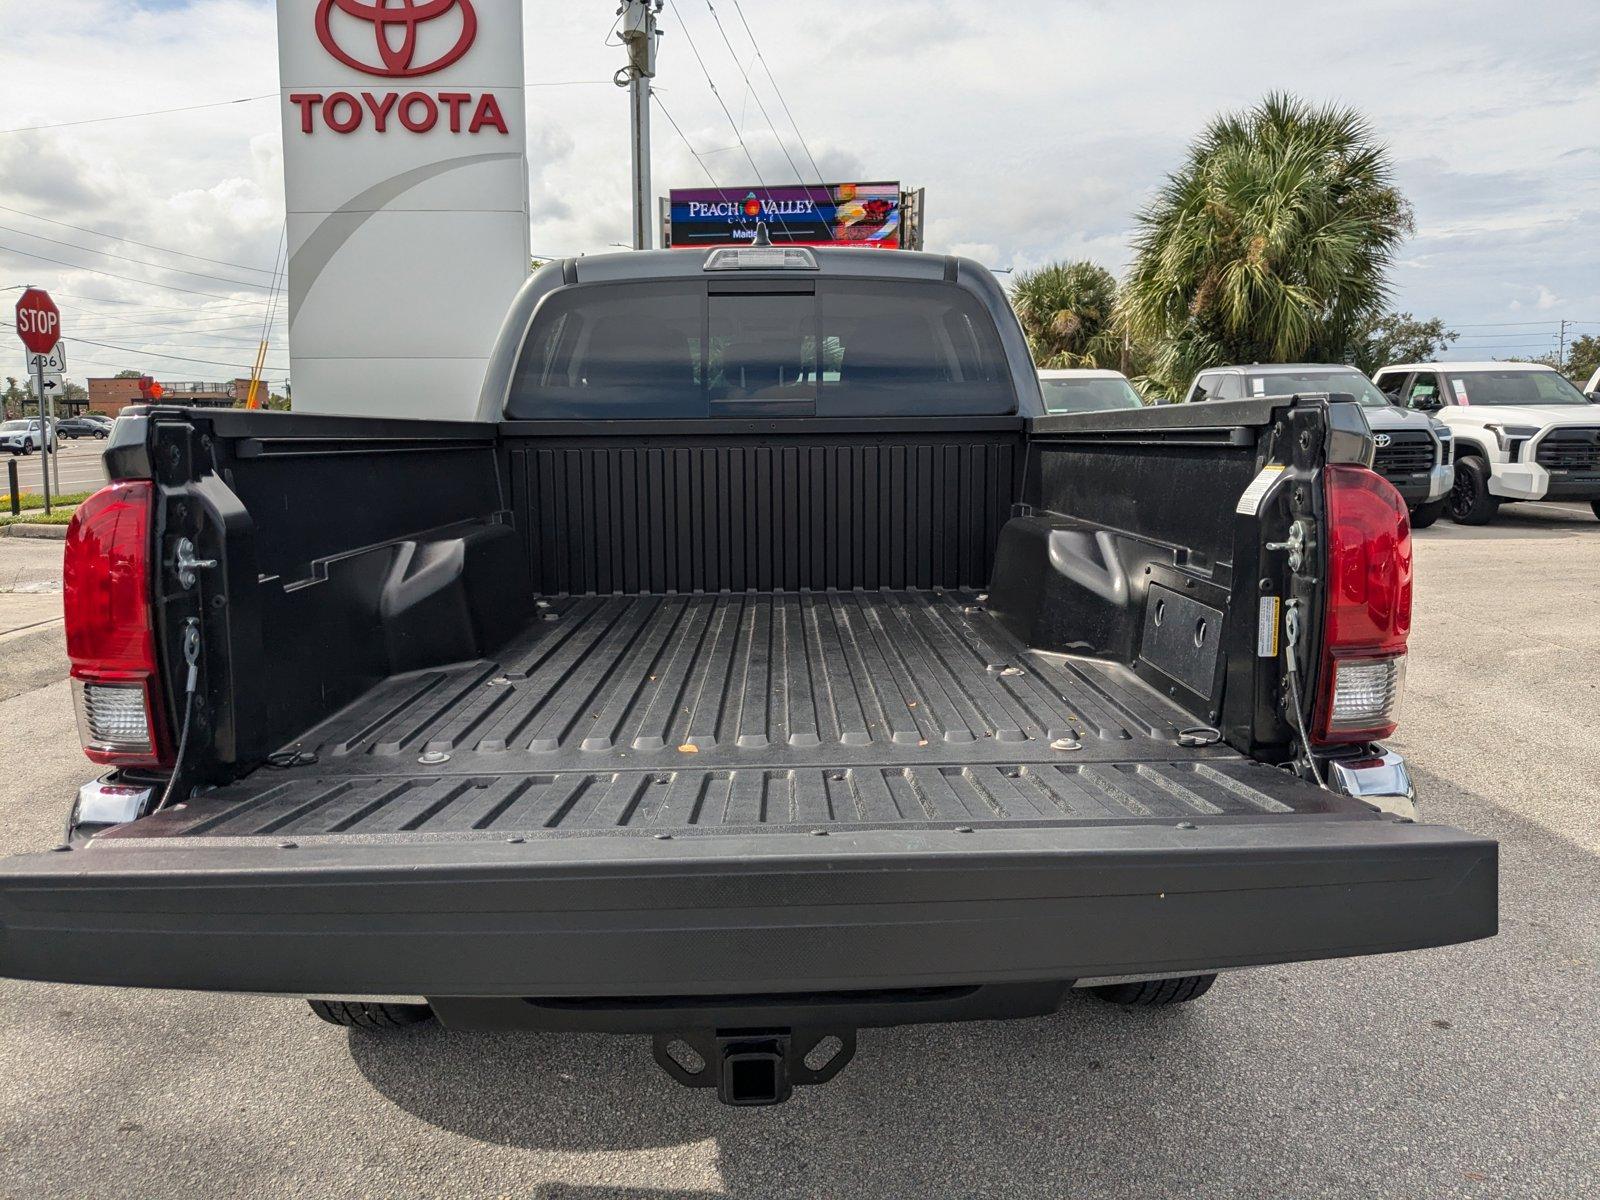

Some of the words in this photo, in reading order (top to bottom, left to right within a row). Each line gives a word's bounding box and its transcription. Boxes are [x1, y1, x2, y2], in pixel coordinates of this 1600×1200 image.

[290, 91, 509, 134] TOYOTA
[688, 201, 739, 217] PEACH
[760, 199, 814, 215] VALLEY
[19, 307, 57, 335] STOP
